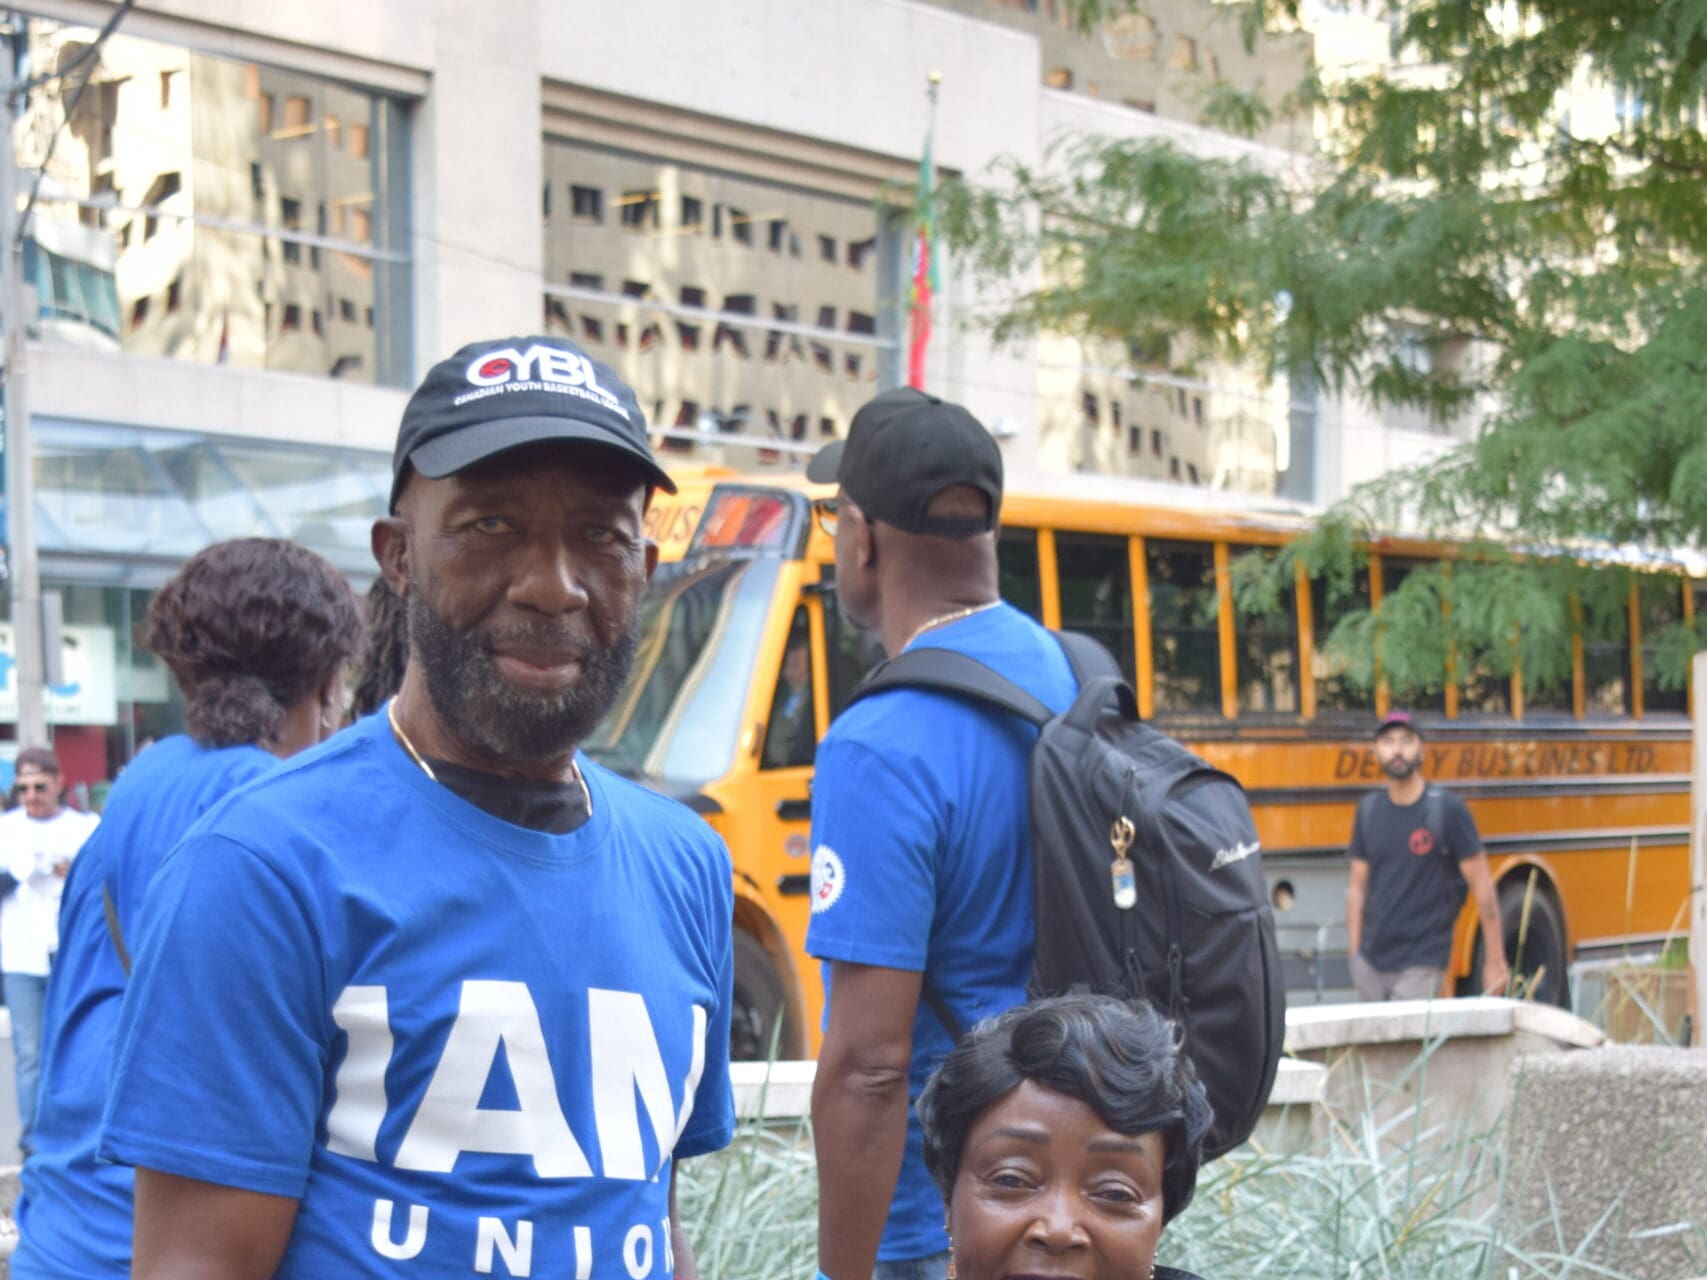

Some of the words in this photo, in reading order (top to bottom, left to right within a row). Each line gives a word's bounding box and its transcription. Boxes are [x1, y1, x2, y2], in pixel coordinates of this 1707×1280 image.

[466, 344, 620, 405] CYBL
[453, 383, 505, 407] CANADIAN
[505, 380, 542, 394] YOUTH
[543, 381, 602, 405] BASKETBALL
[1334, 747, 1450, 780] DEY
[1456, 747, 1517, 778] BUS
